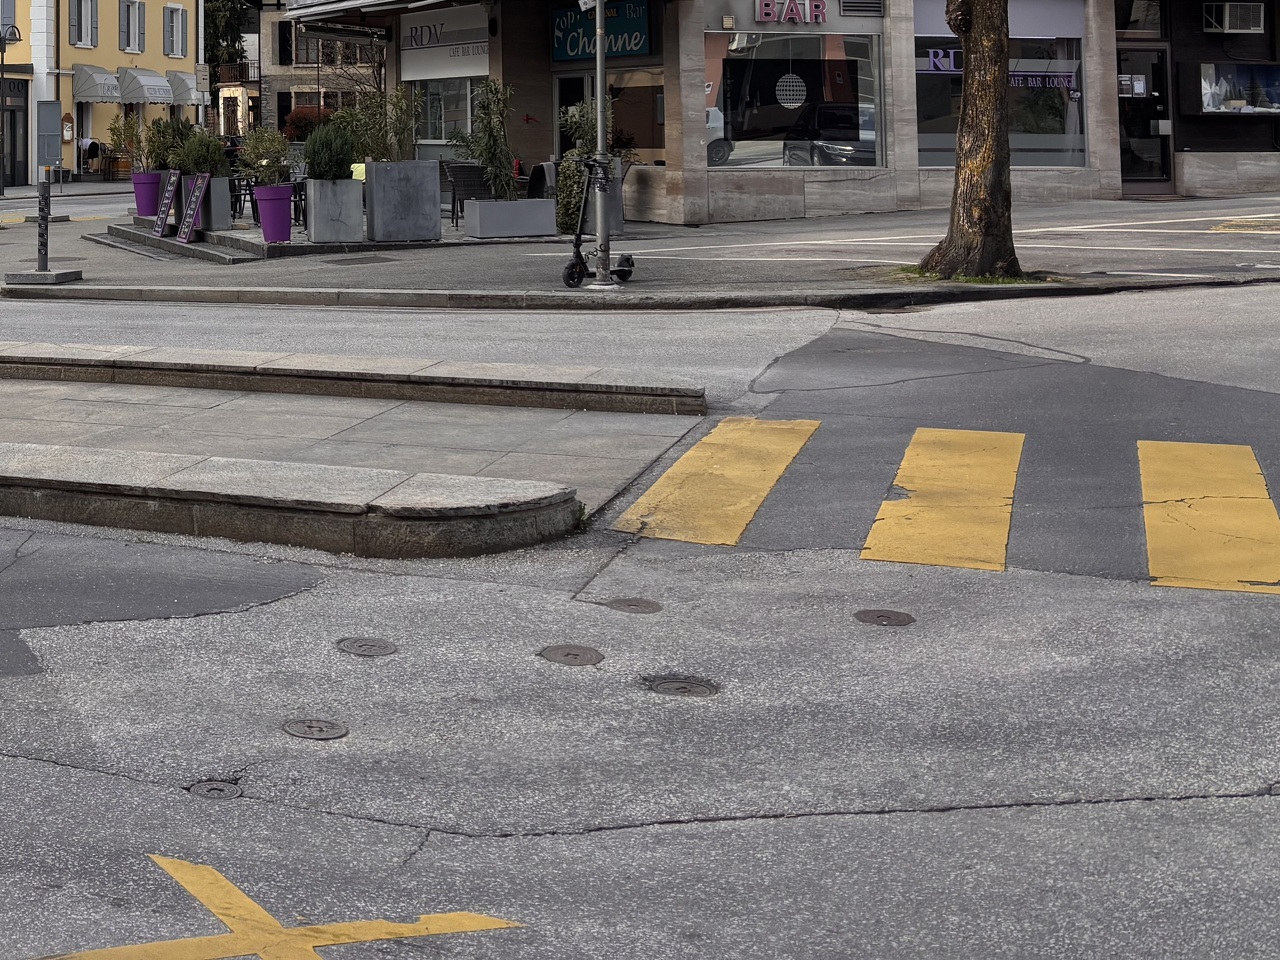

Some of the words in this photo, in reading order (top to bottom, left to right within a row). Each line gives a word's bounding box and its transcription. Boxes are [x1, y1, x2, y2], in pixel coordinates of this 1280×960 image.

[626, 3, 645, 19] Bar
[409, 23, 445, 47] RDV
[449, 47, 460, 58] CAFE
[461, 46, 471, 57] BAR
[472, 44, 489, 56] LOUNG
[926, 49, 964, 71] RD
[1008, 77, 1024, 88] AFE
[1028, 78, 1042, 88] BAR
